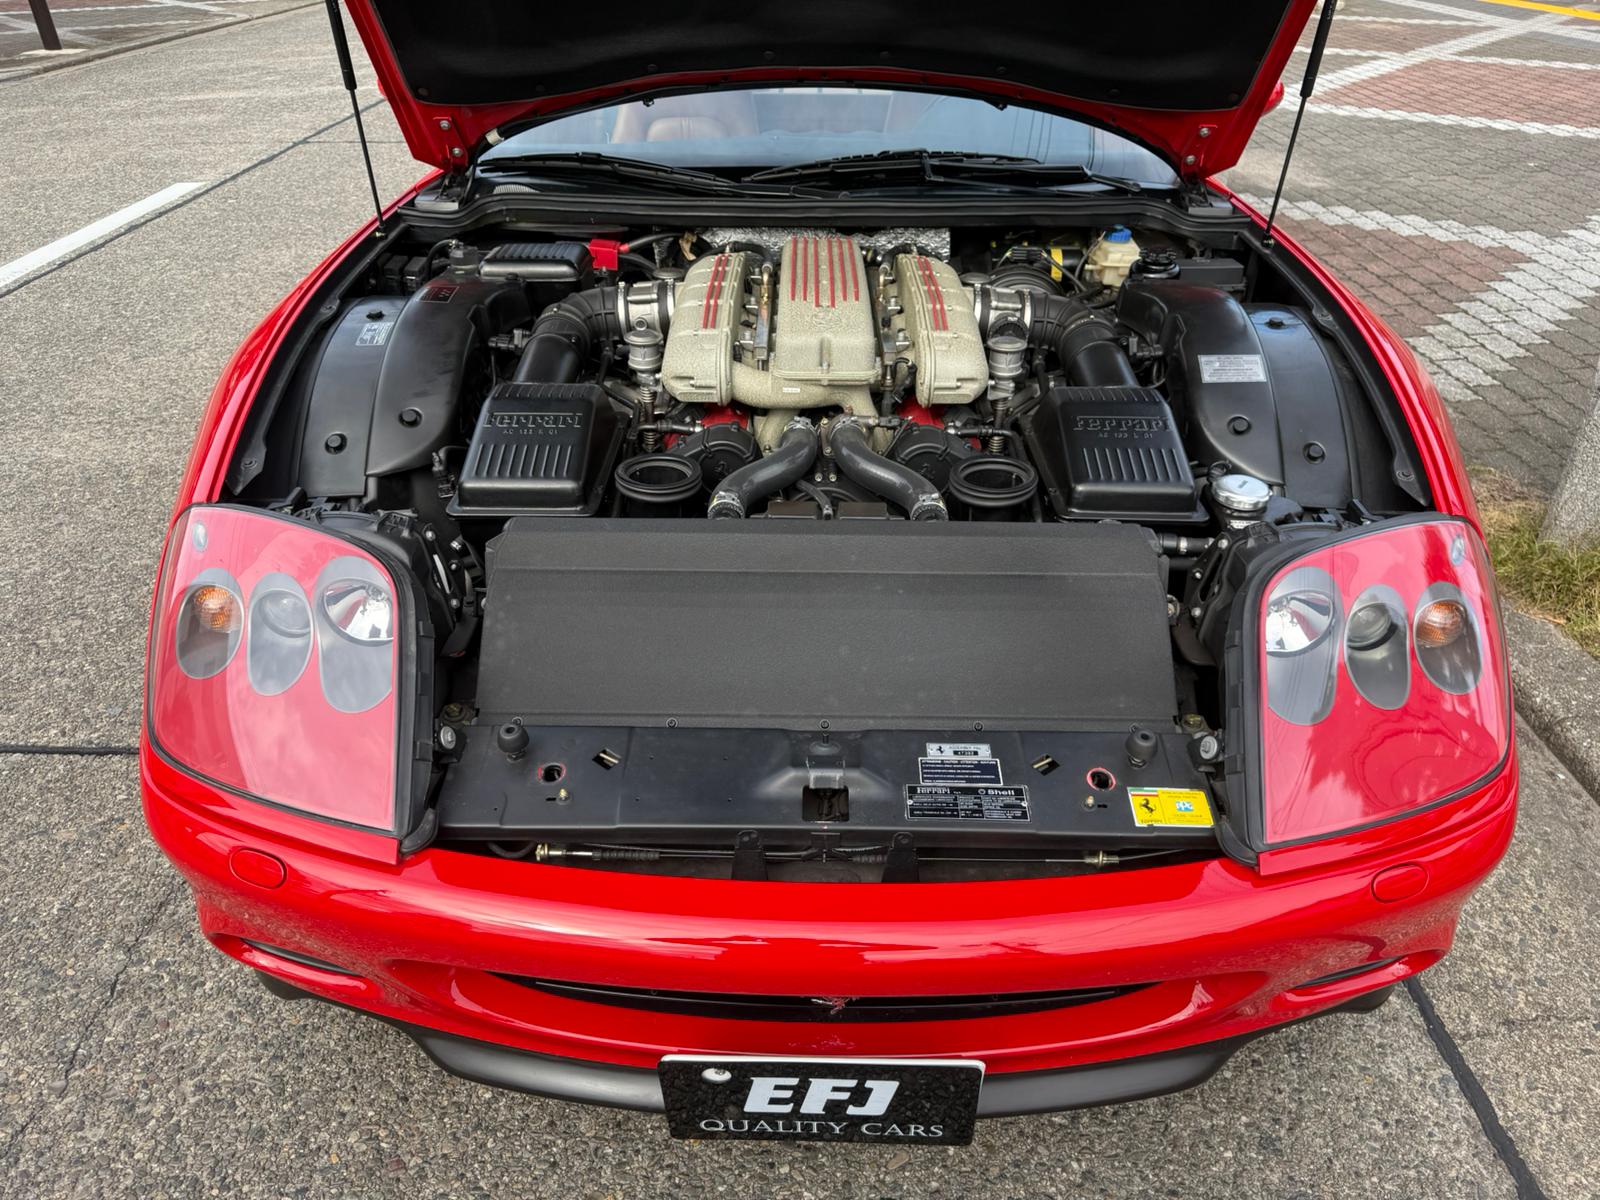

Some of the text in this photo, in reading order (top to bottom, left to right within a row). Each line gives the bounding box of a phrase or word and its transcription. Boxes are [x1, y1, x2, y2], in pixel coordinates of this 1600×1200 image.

[483, 412, 583, 428] Ferrari
[1072, 415, 1173, 432] Ferrari
[743, 1077, 900, 1116] EFJ
[700, 1119, 944, 1137] QUALITY CARS
